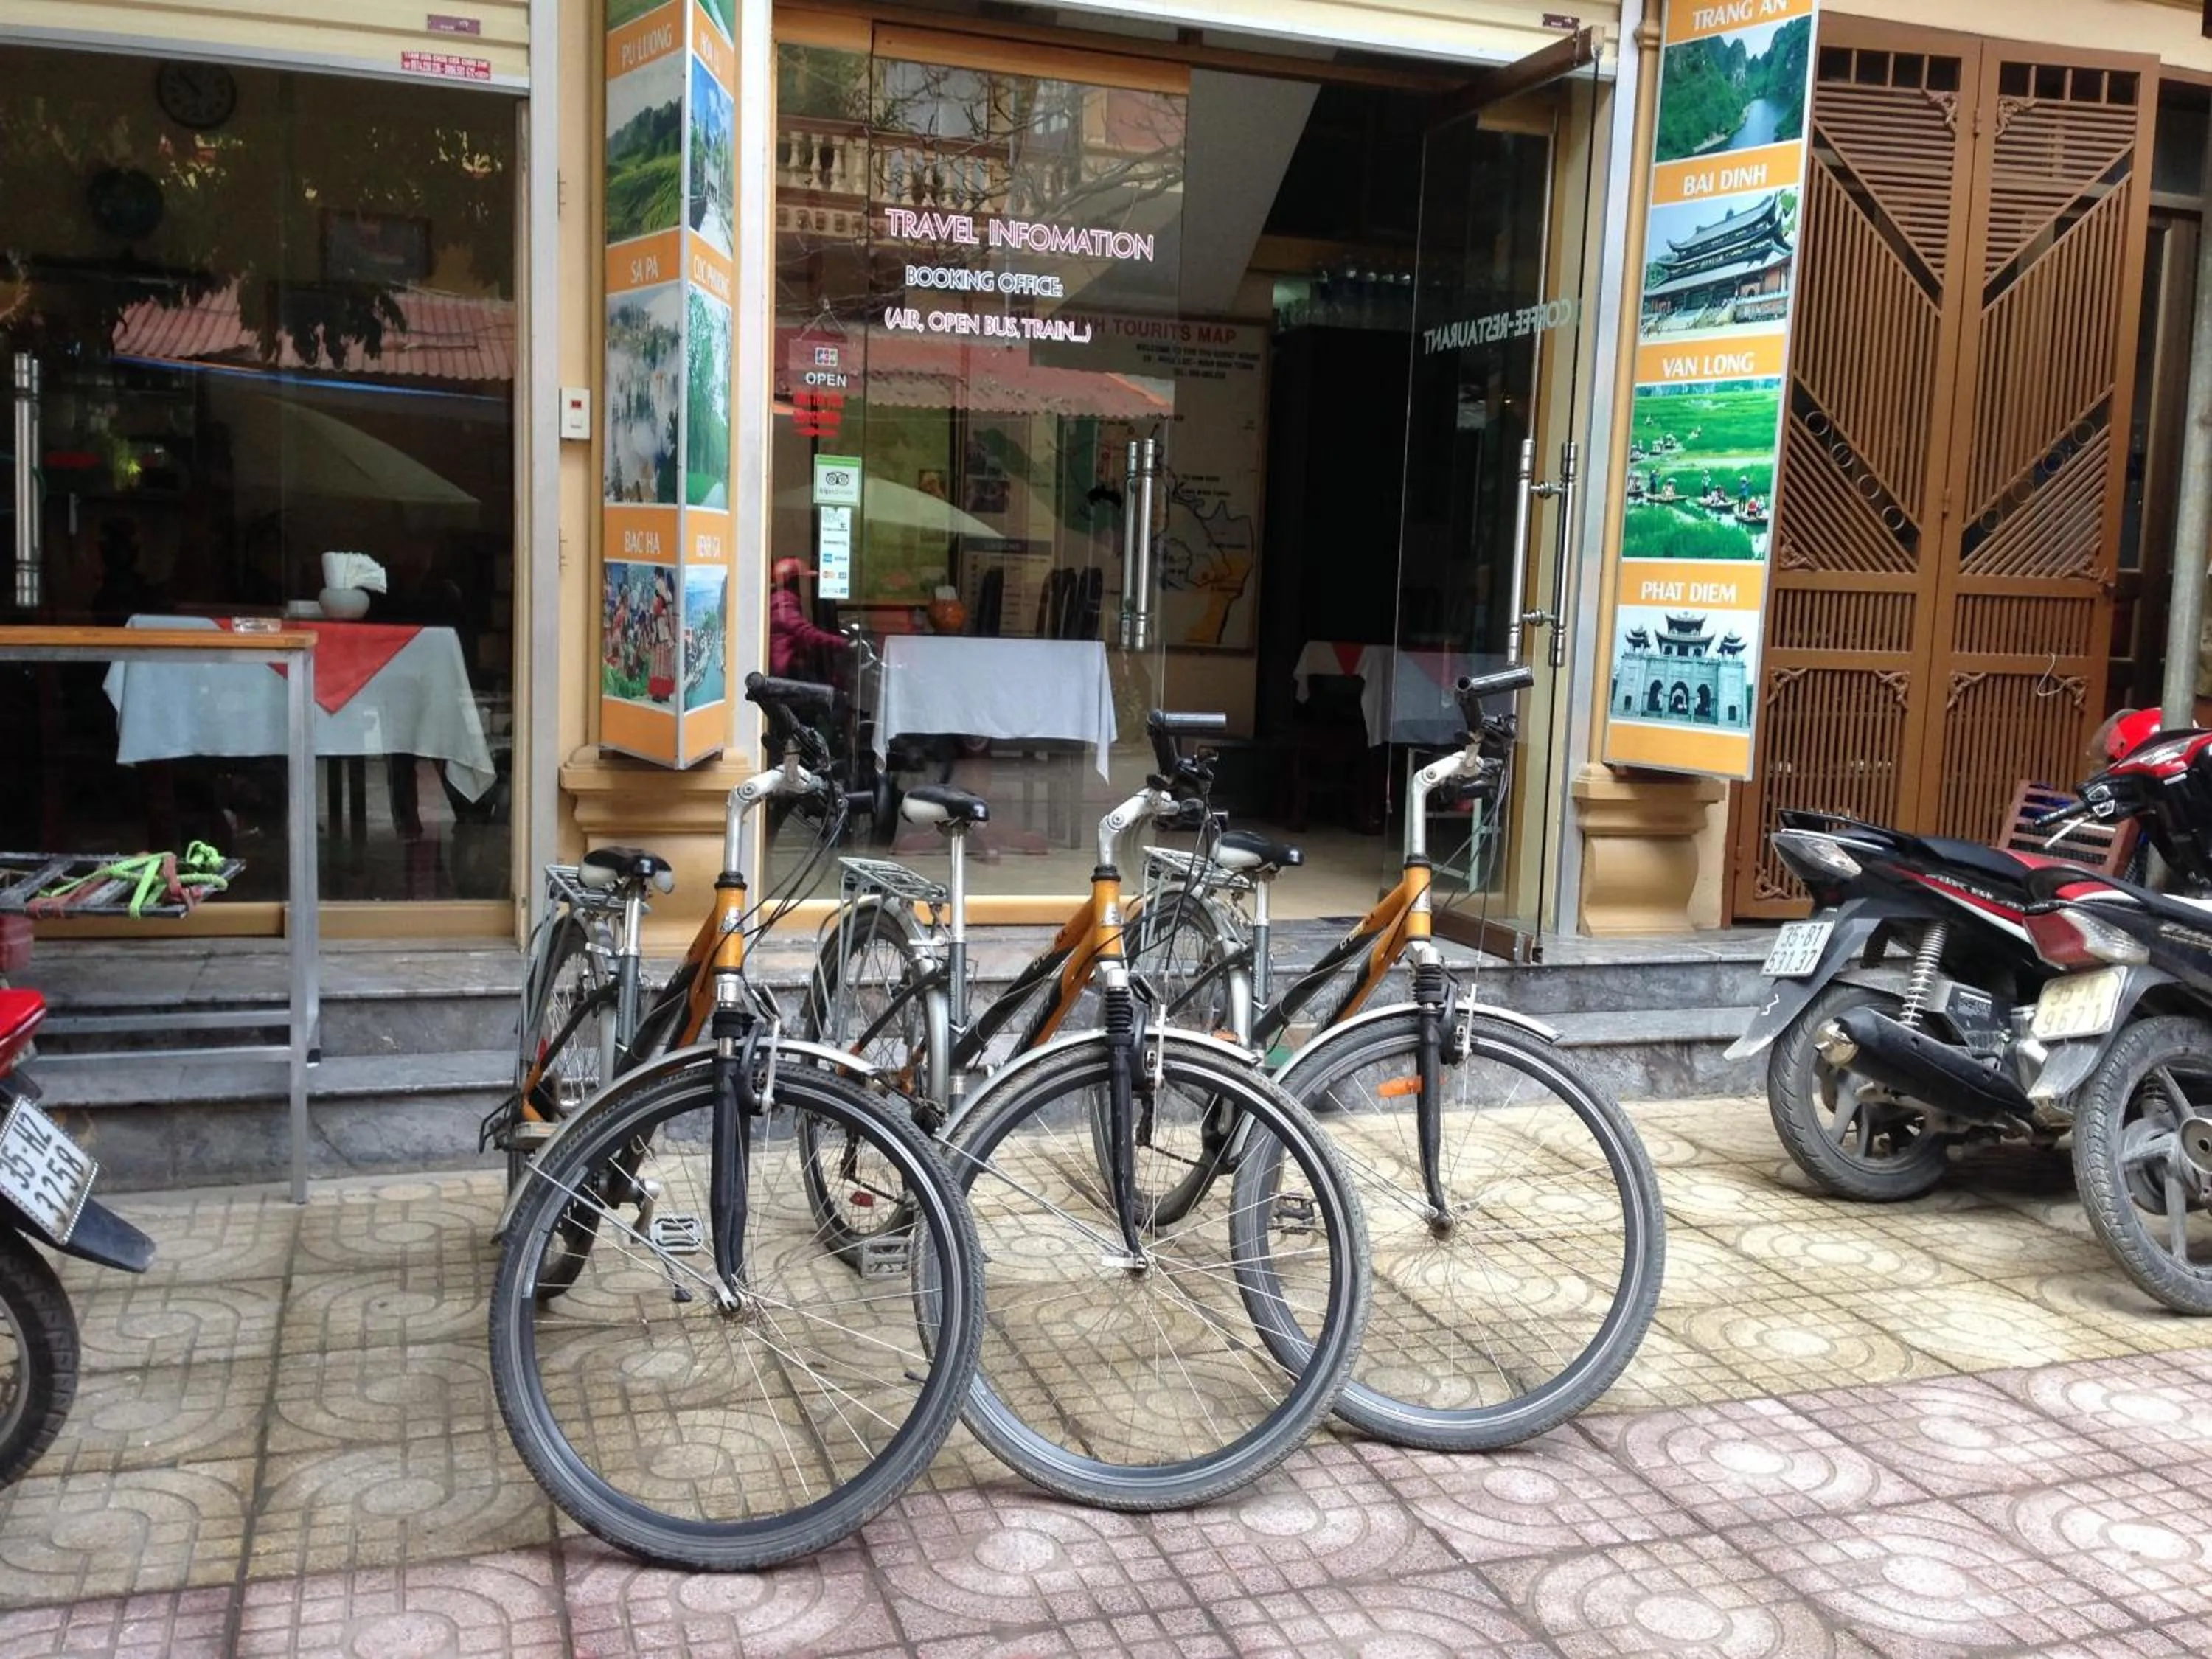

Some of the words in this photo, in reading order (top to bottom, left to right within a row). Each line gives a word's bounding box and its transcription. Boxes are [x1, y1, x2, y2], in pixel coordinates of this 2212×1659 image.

[1693, 1, 1754, 31] TRANG
[622, 38, 636, 69] PU
[638, 24, 672, 61] LUONG
[1683, 171, 1715, 196] BAI
[1720, 163, 1768, 190] DINH
[885, 208, 979, 244] TRAVEL
[989, 219, 1154, 261] INFOMATION
[631, 259, 643, 283] SA
[646, 255, 658, 281] PA
[905, 265, 993, 291] BOOKING
[927, 310, 979, 335] OPEN
[1197, 329, 1237, 345] MAP
[1663, 356, 1699, 378] VAN
[1703, 352, 1755, 375] LONG
[806, 371, 847, 387] OPEN
[625, 530, 644, 554] BAC
[646, 531, 661, 555] HA
[1641, 580, 1686, 601] PHAT
[1689, 582, 1736, 603] DIEM
